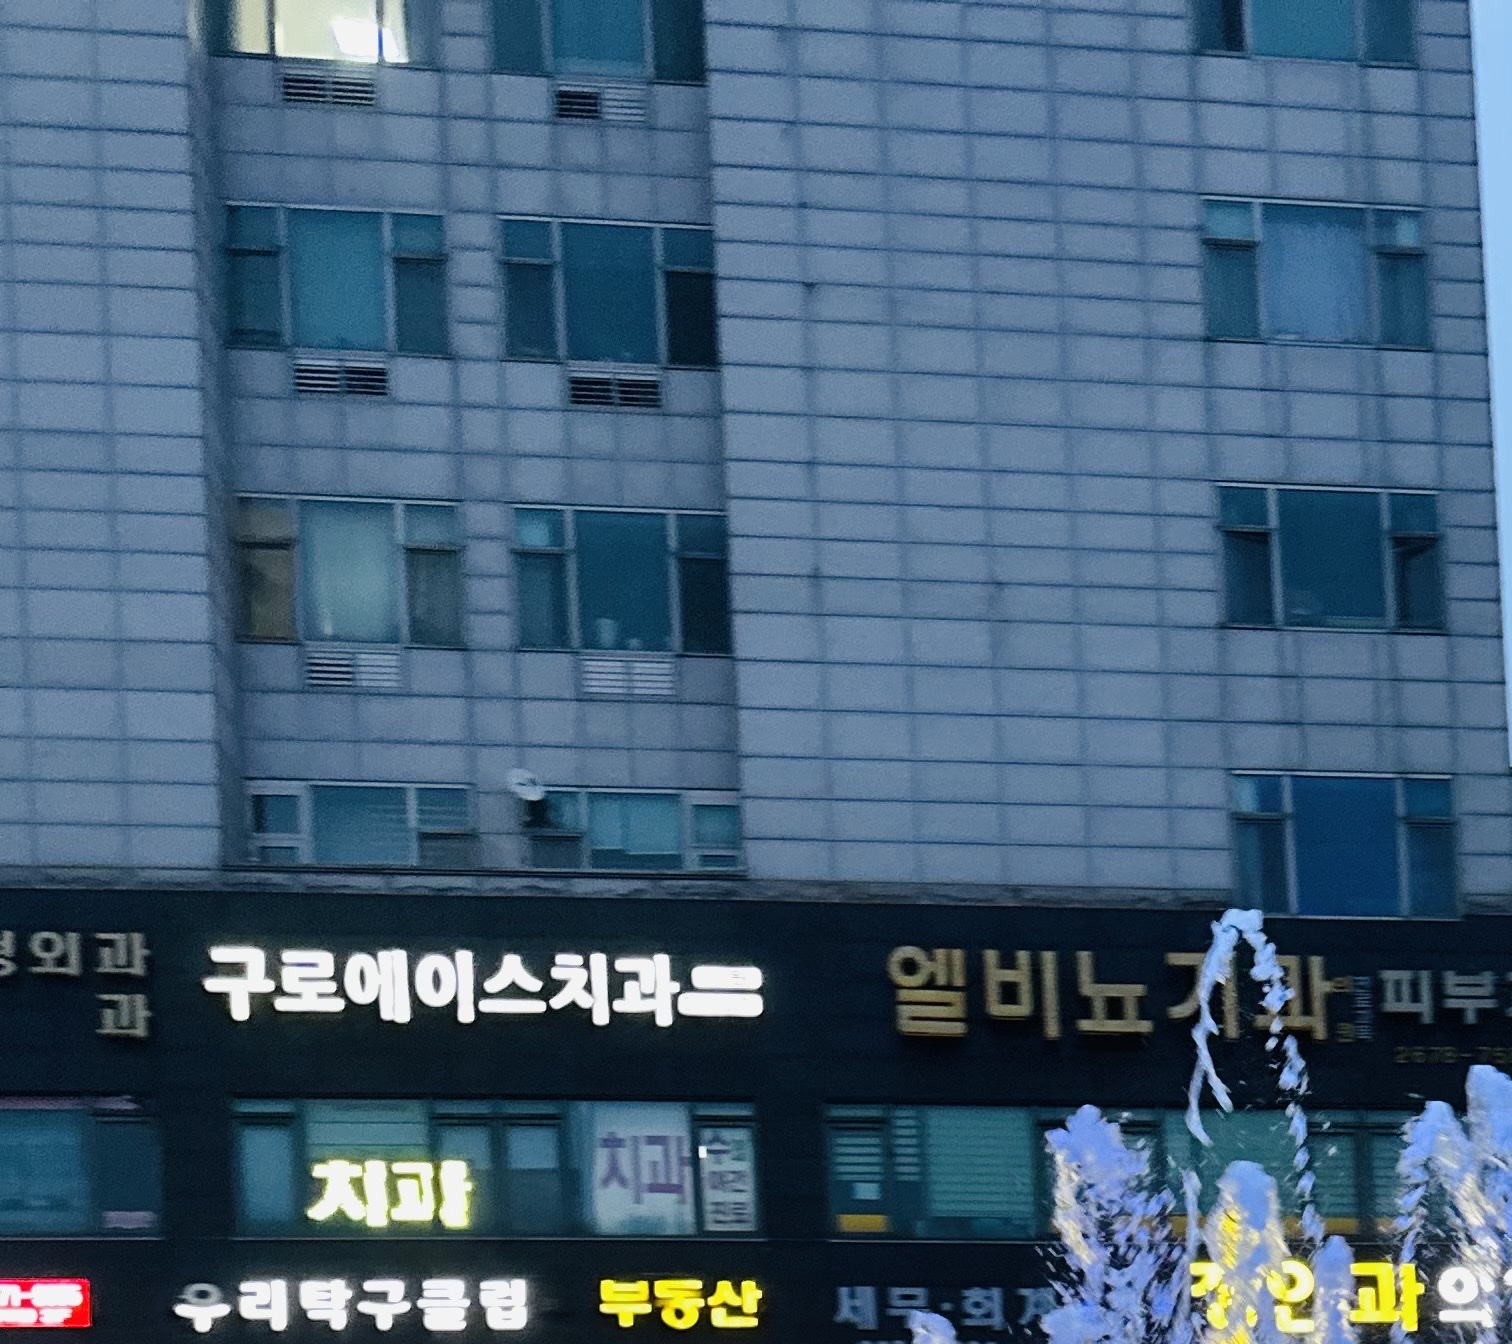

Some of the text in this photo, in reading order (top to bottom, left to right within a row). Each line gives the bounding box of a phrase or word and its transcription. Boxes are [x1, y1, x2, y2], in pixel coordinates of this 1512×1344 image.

[96, 993, 151, 1037] 과
[204, 946, 680, 1027] 구로에이스치과
[887, 945, 1332, 1041] 엘비뇨기과
[307, 1160, 473, 1229] 치과
[600, 1132, 691, 1204] 치과
[174, 1279, 528, 1332] 우리탁구클럽
[600, 1279, 762, 1328] 부동산
